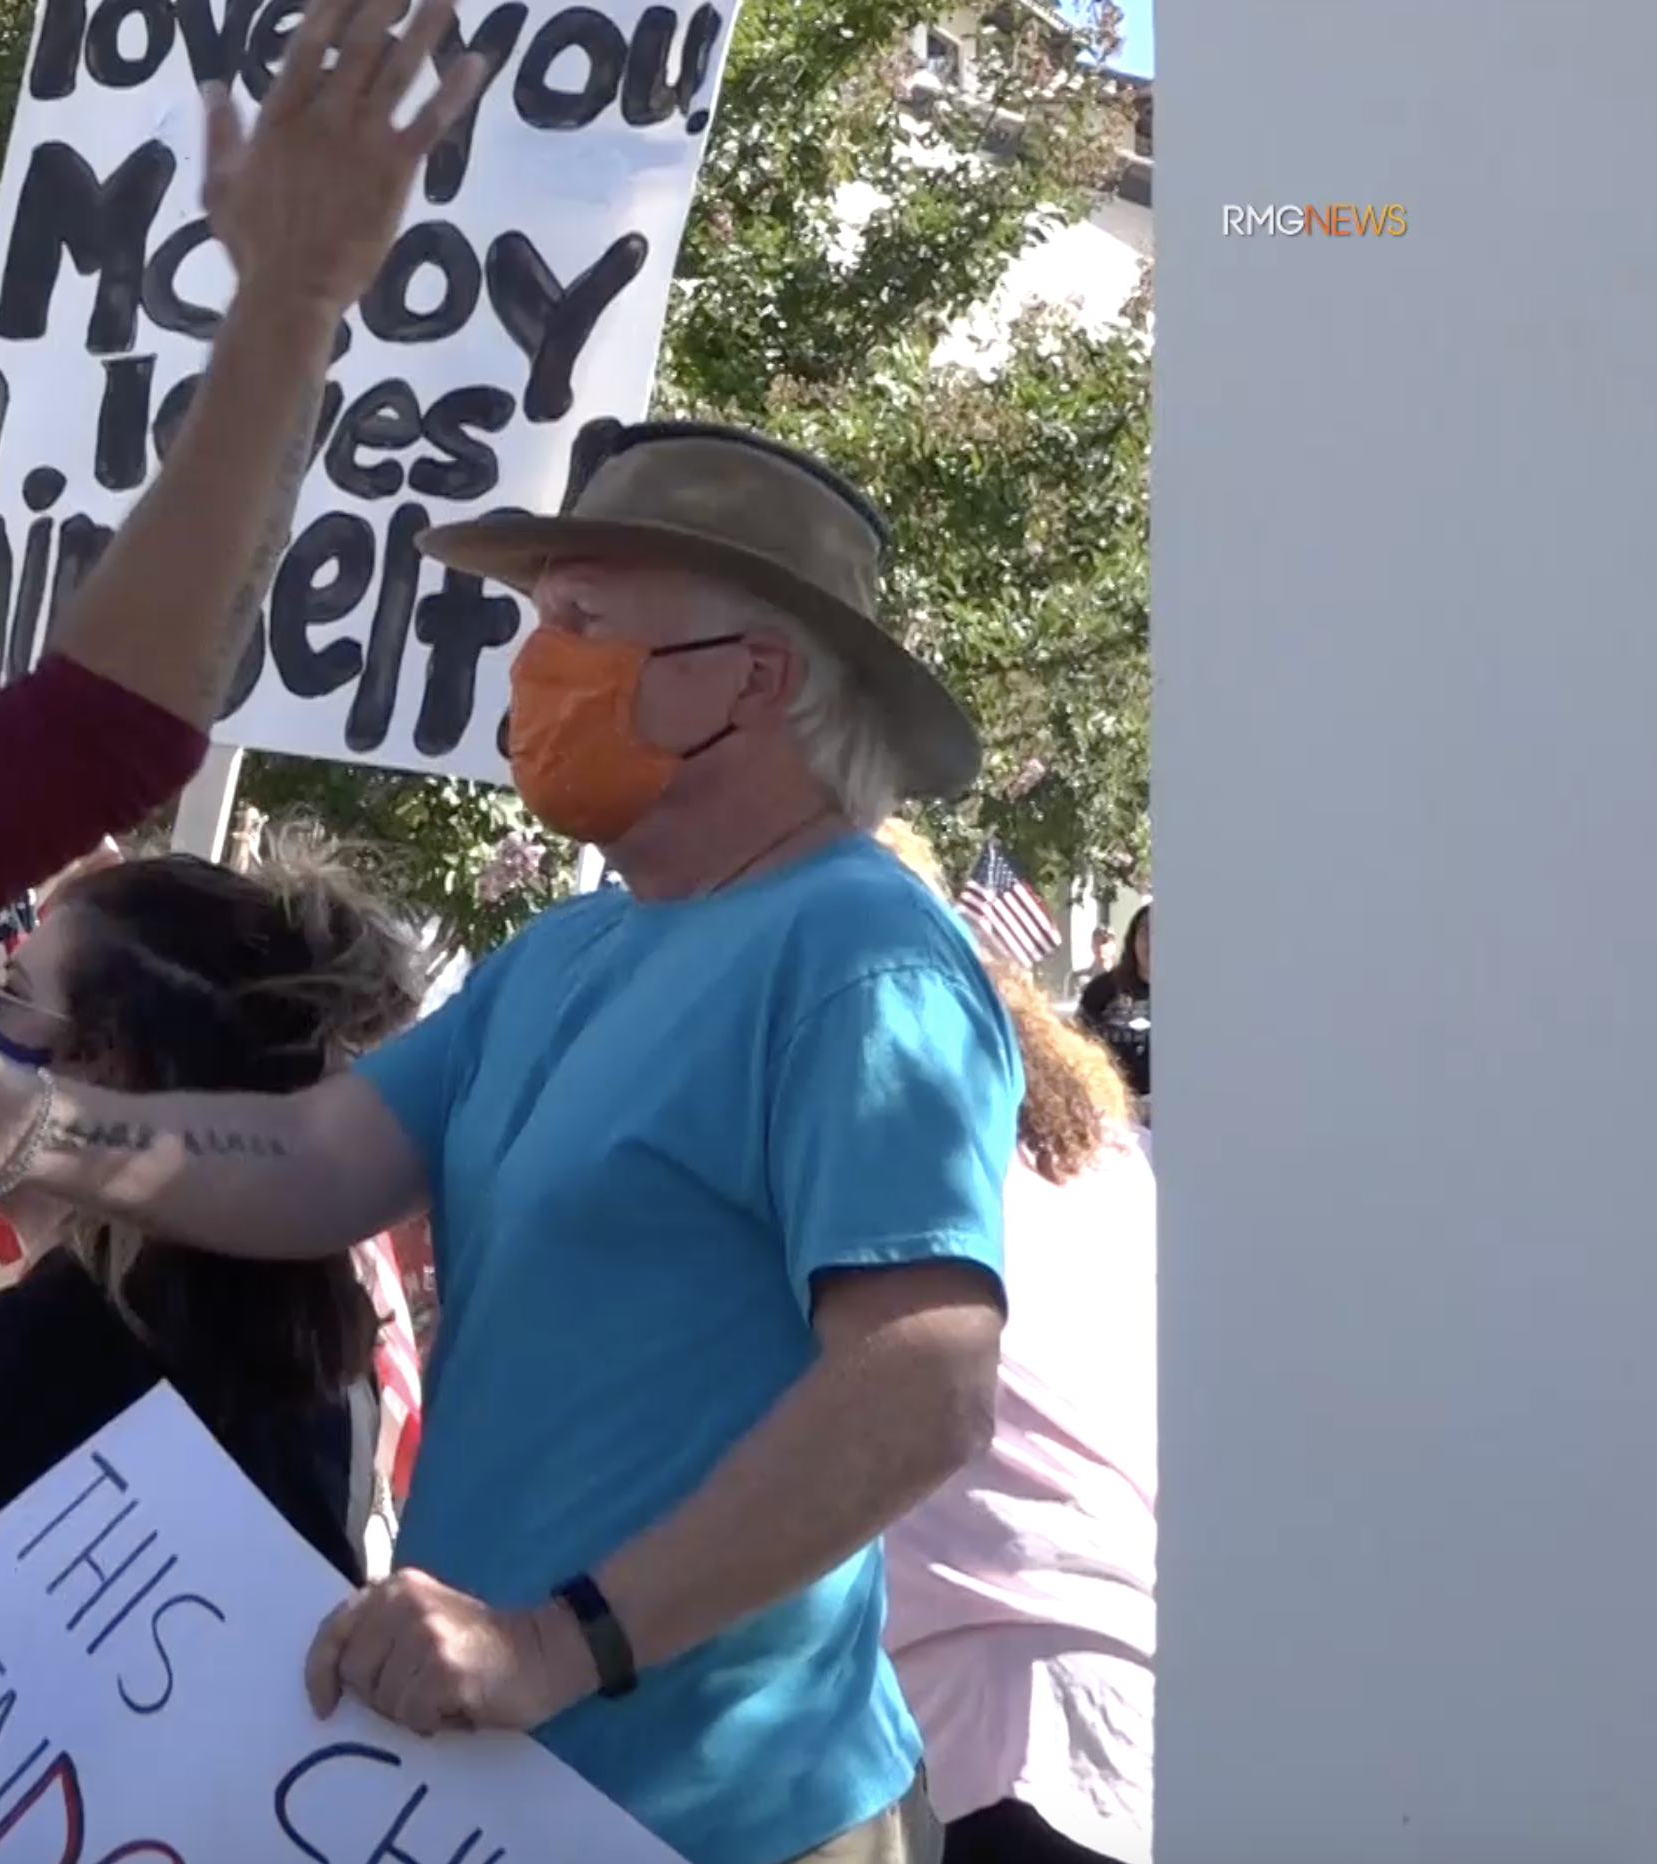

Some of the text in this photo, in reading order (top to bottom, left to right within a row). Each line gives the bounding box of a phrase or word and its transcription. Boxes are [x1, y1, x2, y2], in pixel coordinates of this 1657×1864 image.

[29, 0, 723, 206] love you!
[16, 1451, 226, 1716] THIS
